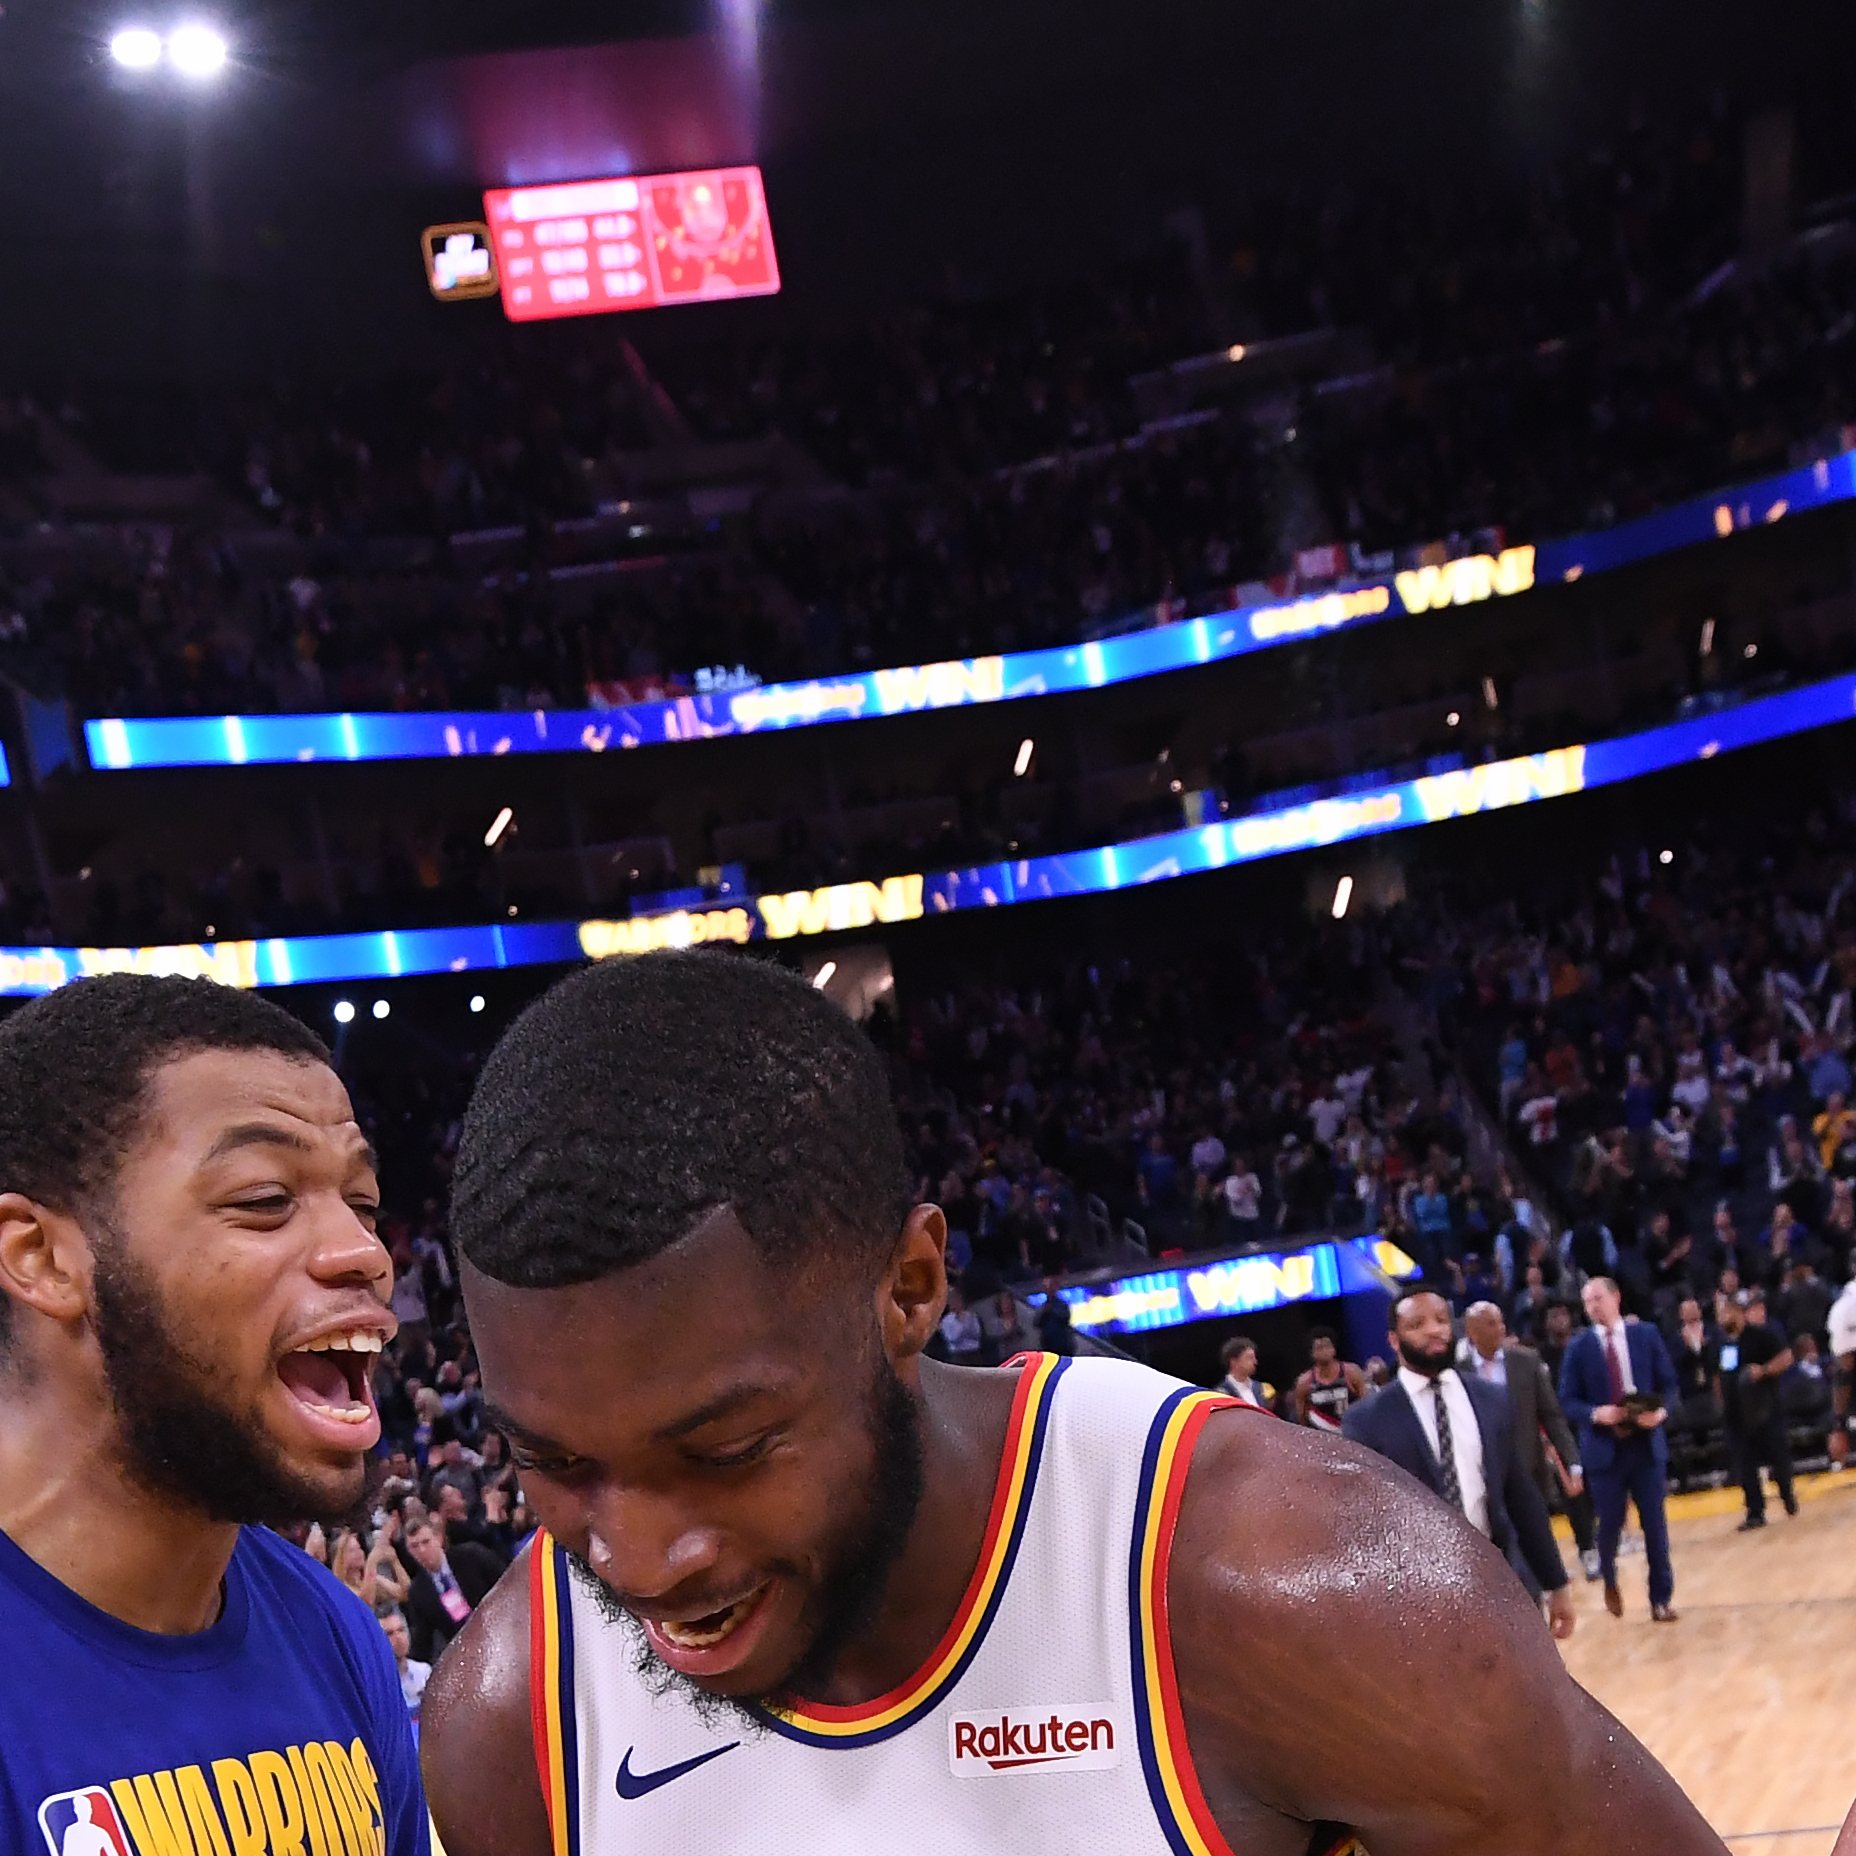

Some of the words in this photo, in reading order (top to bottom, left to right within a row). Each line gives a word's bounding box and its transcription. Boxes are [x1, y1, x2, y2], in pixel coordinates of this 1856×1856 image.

[1396, 546, 1533, 613] WIN!
[876, 656, 1002, 714] WIN!
[1415, 746, 1585, 820] WIN!
[760, 875, 923, 937] WIN!
[954, 1714, 1113, 1760] Rakuten
